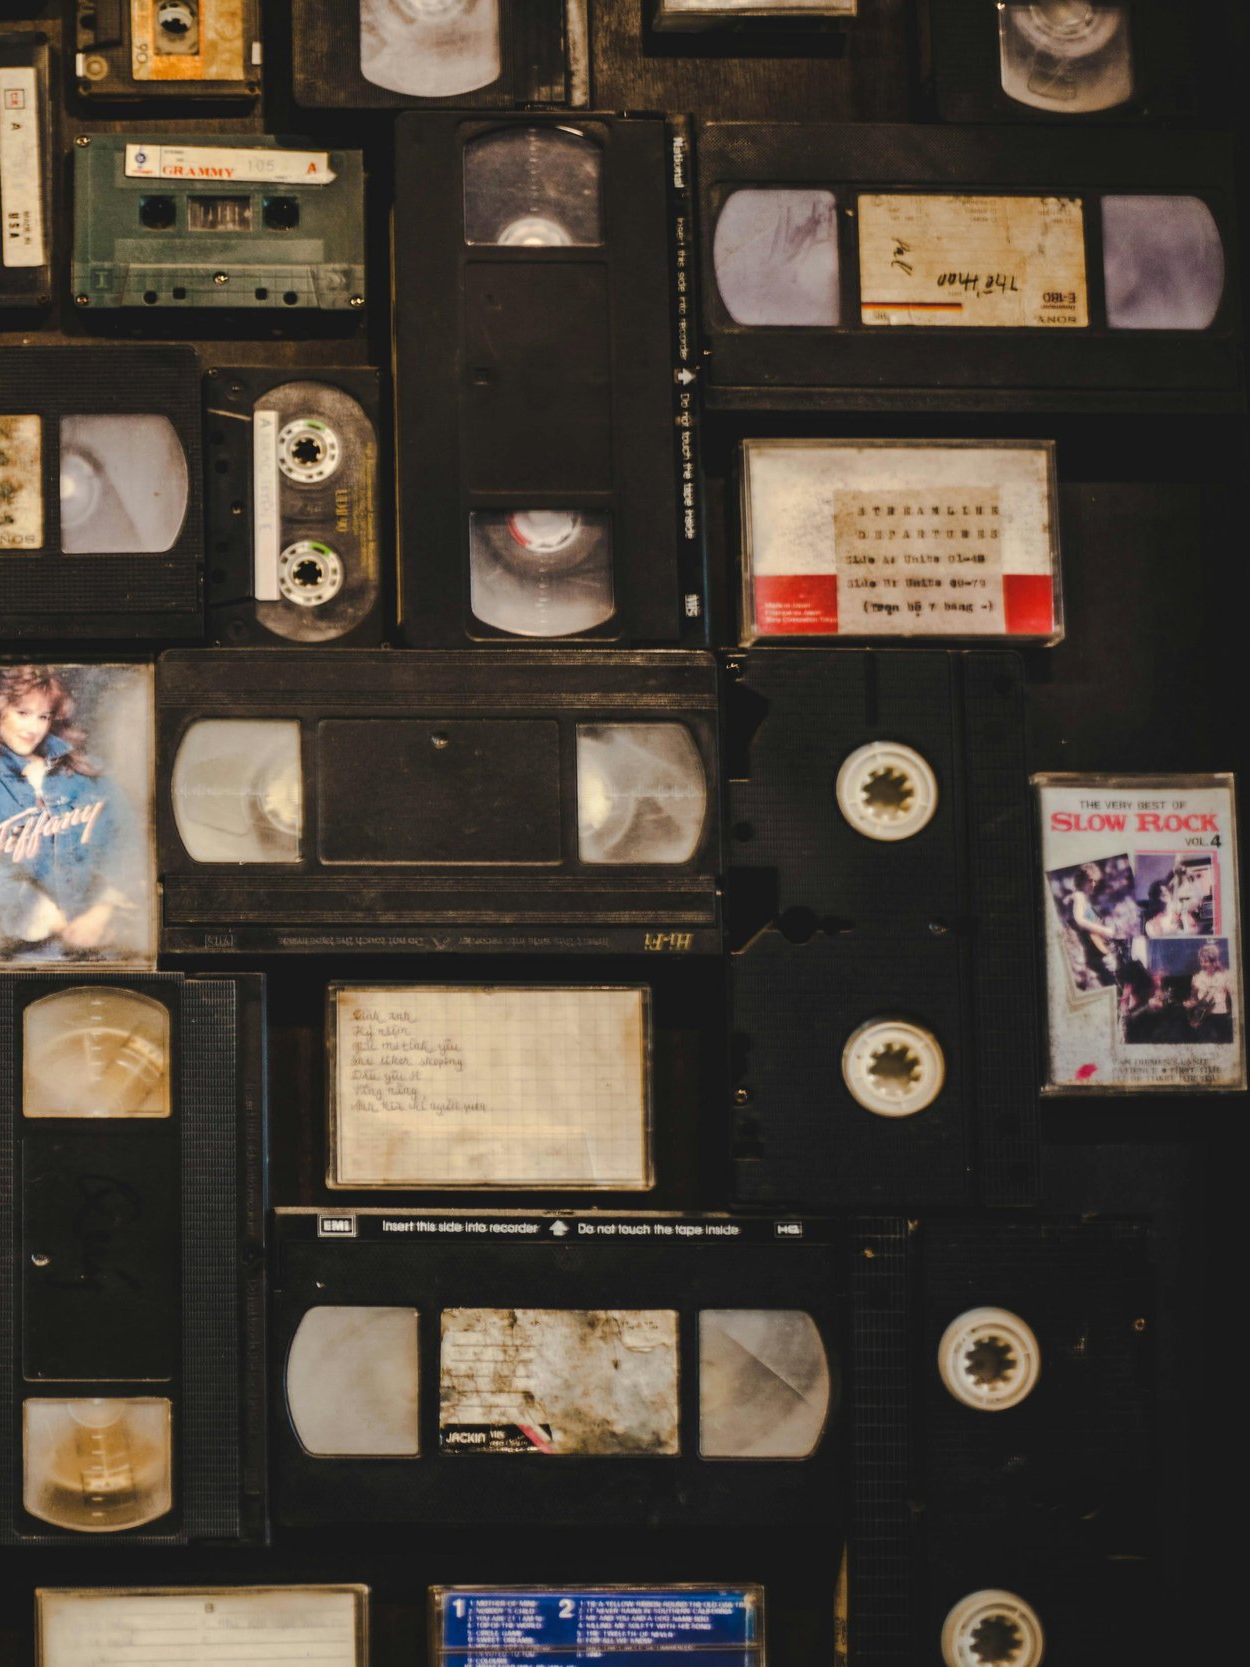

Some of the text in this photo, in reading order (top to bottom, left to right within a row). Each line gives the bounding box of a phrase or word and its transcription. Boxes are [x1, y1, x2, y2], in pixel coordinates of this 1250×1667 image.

[306, 162, 316, 174] A
[673, 137, 685, 188] National
[163, 165, 234, 178] GRAMMY
[678, 297, 686, 314] into
[679, 318, 688, 360] recorder
[681, 393, 690, 407] Do
[682, 432, 692, 459] touch
[683, 463, 693, 479] the
[683, 483, 694, 506] tape
[685, 509, 695, 539] inside
[846, 554, 875, 564] Side
[904, 554, 940, 564] Units
[847, 578, 876, 588] Side
[906, 578, 941, 588] Units
[1080, 800, 1186, 810] THE VERY BEST OF
[1050, 812, 1220, 832] SLOW ROCK
[1210, 835, 1222, 848] 4
[356, 937, 385, 946] touch
[643, 932, 693, 951] Hi-Fi
[323, 1220, 350, 1231] EMI
[383, 1220, 540, 1234] Insert this side into recorder
[578, 1223, 741, 1236] Do not touch the tape inside
[453, 1599, 464, 1618] 1
[559, 1599, 575, 1618] 2
